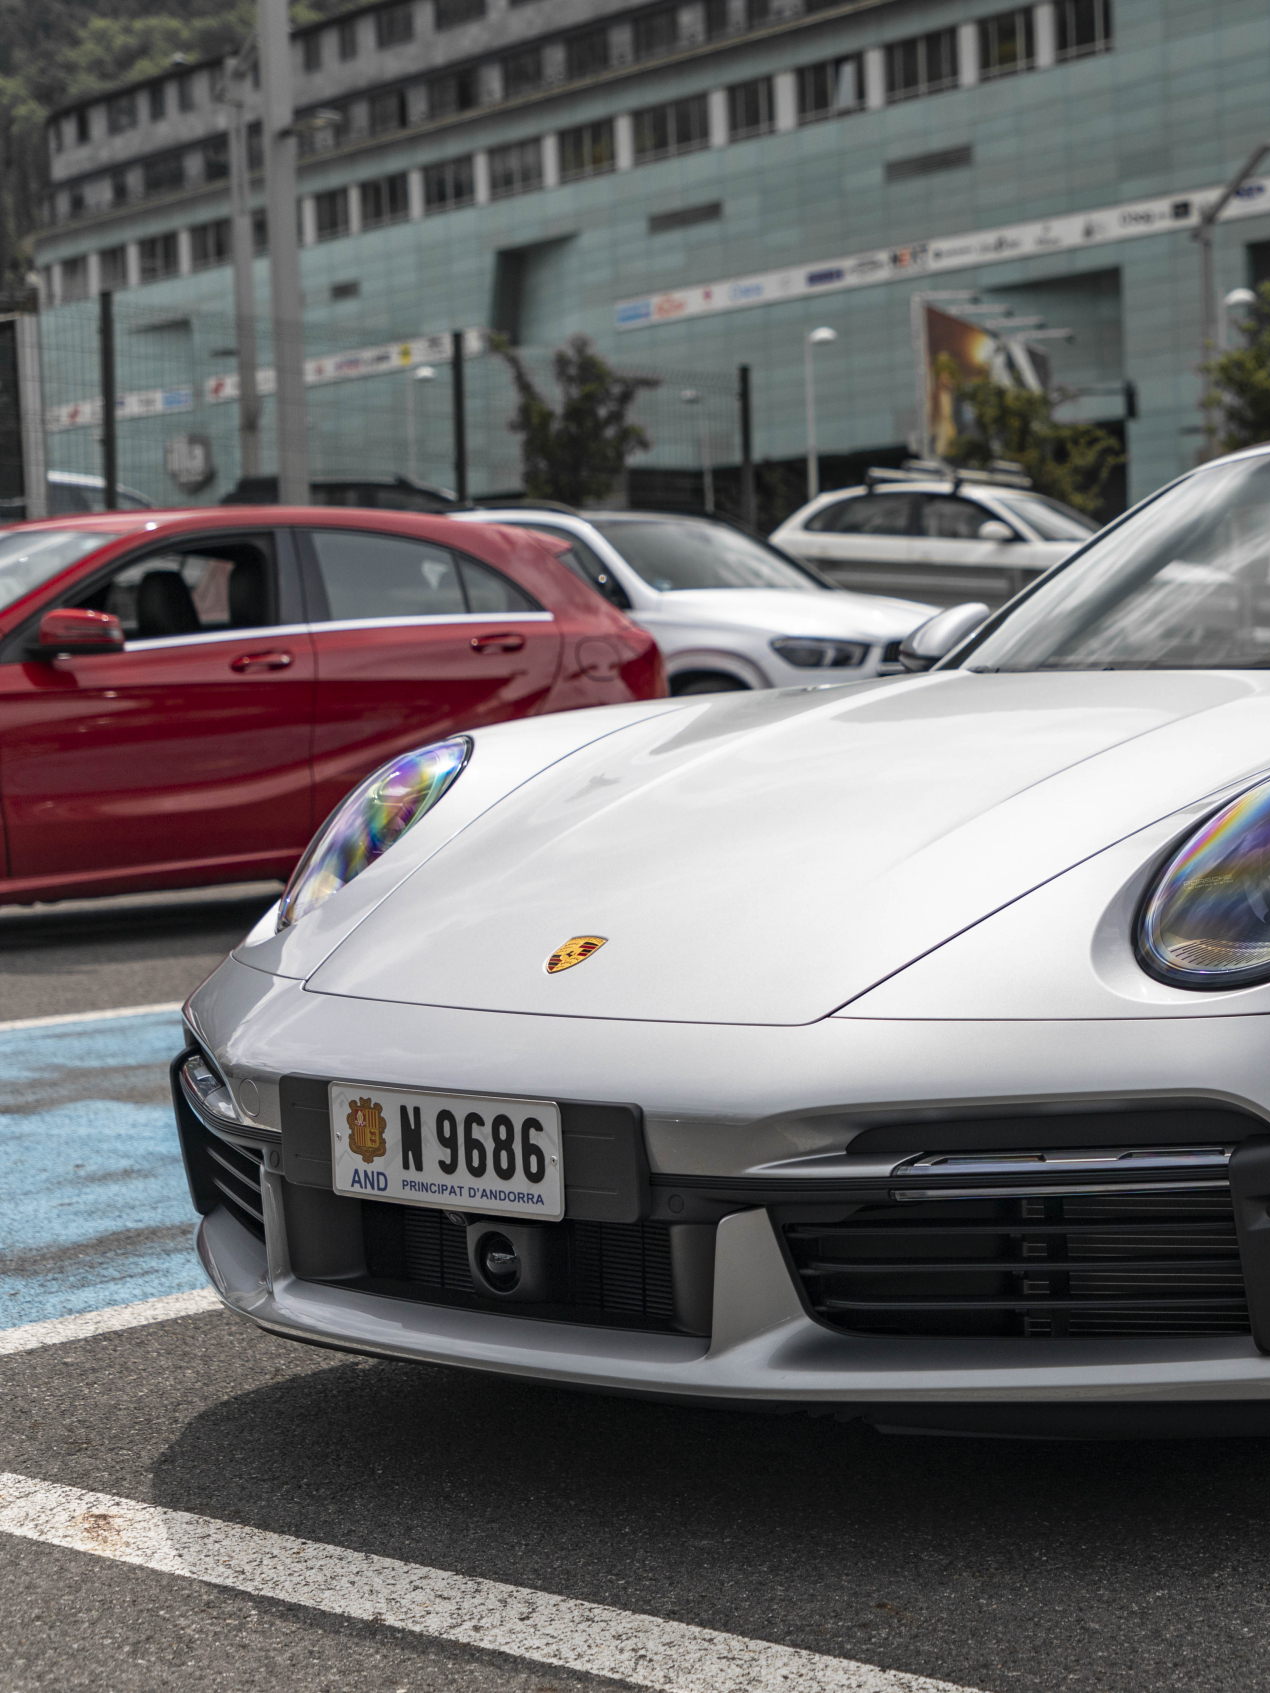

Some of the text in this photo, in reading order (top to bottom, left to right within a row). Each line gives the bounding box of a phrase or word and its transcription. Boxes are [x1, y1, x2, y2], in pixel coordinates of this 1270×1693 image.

[1183, 874, 1233, 886] PORSCHE
[400, 1104, 546, 1184] N 9686
[350, 1168, 545, 1206] AND PRINCIPAT D'ANDORRA
